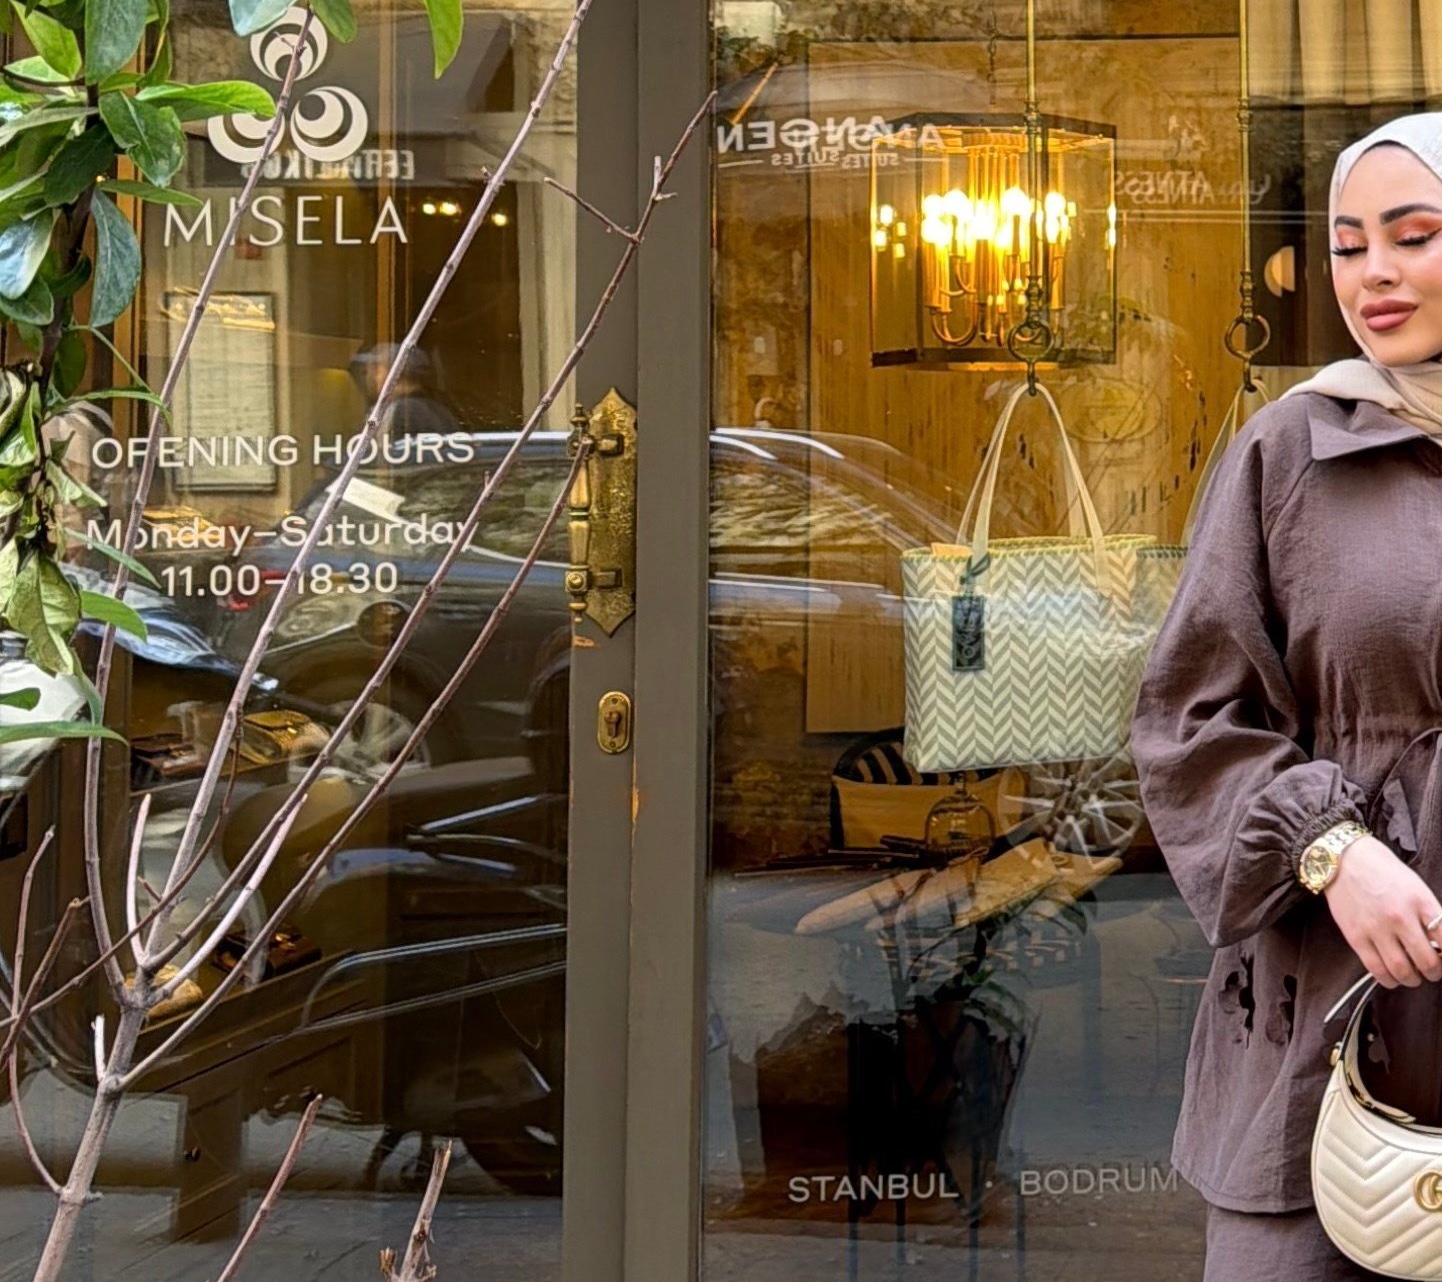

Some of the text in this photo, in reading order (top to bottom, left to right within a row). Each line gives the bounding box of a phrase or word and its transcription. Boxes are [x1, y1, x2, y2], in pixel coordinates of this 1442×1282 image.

[164, 195, 408, 247] MISELA
[92, 432, 475, 469] OPENING HOURS
[788, 1167, 1178, 1203] STANBUL BODRUM
